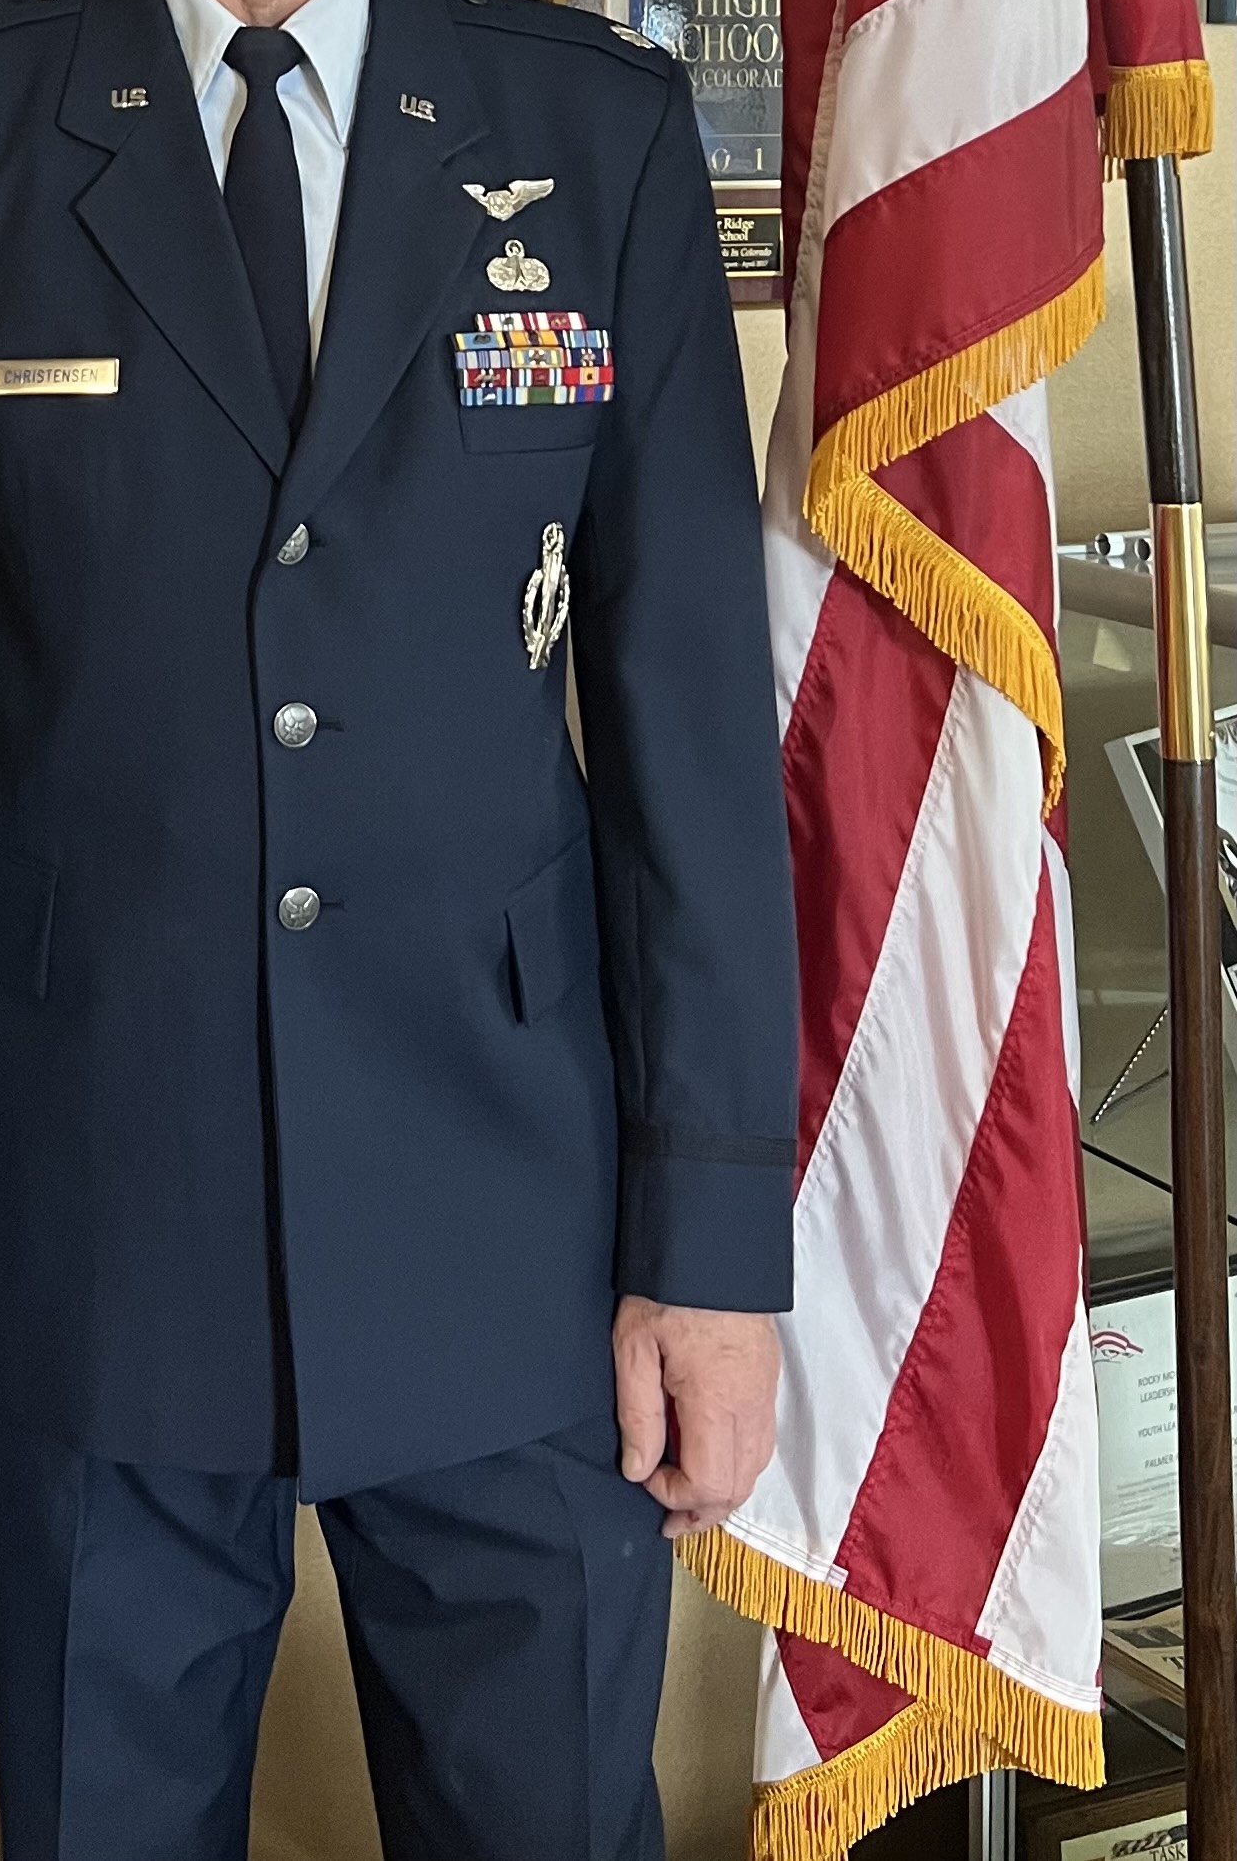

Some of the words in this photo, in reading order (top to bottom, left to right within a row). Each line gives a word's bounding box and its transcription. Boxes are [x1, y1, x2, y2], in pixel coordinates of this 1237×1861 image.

[702, 68, 783, 88] COLORAD
[723, 217, 755, 232] Ridge
[3, 368, 99, 385] CHRISTENSEN
[1137, 1425, 1162, 1439] YOUTH
[1144, 1454, 1174, 1469] PALMER
